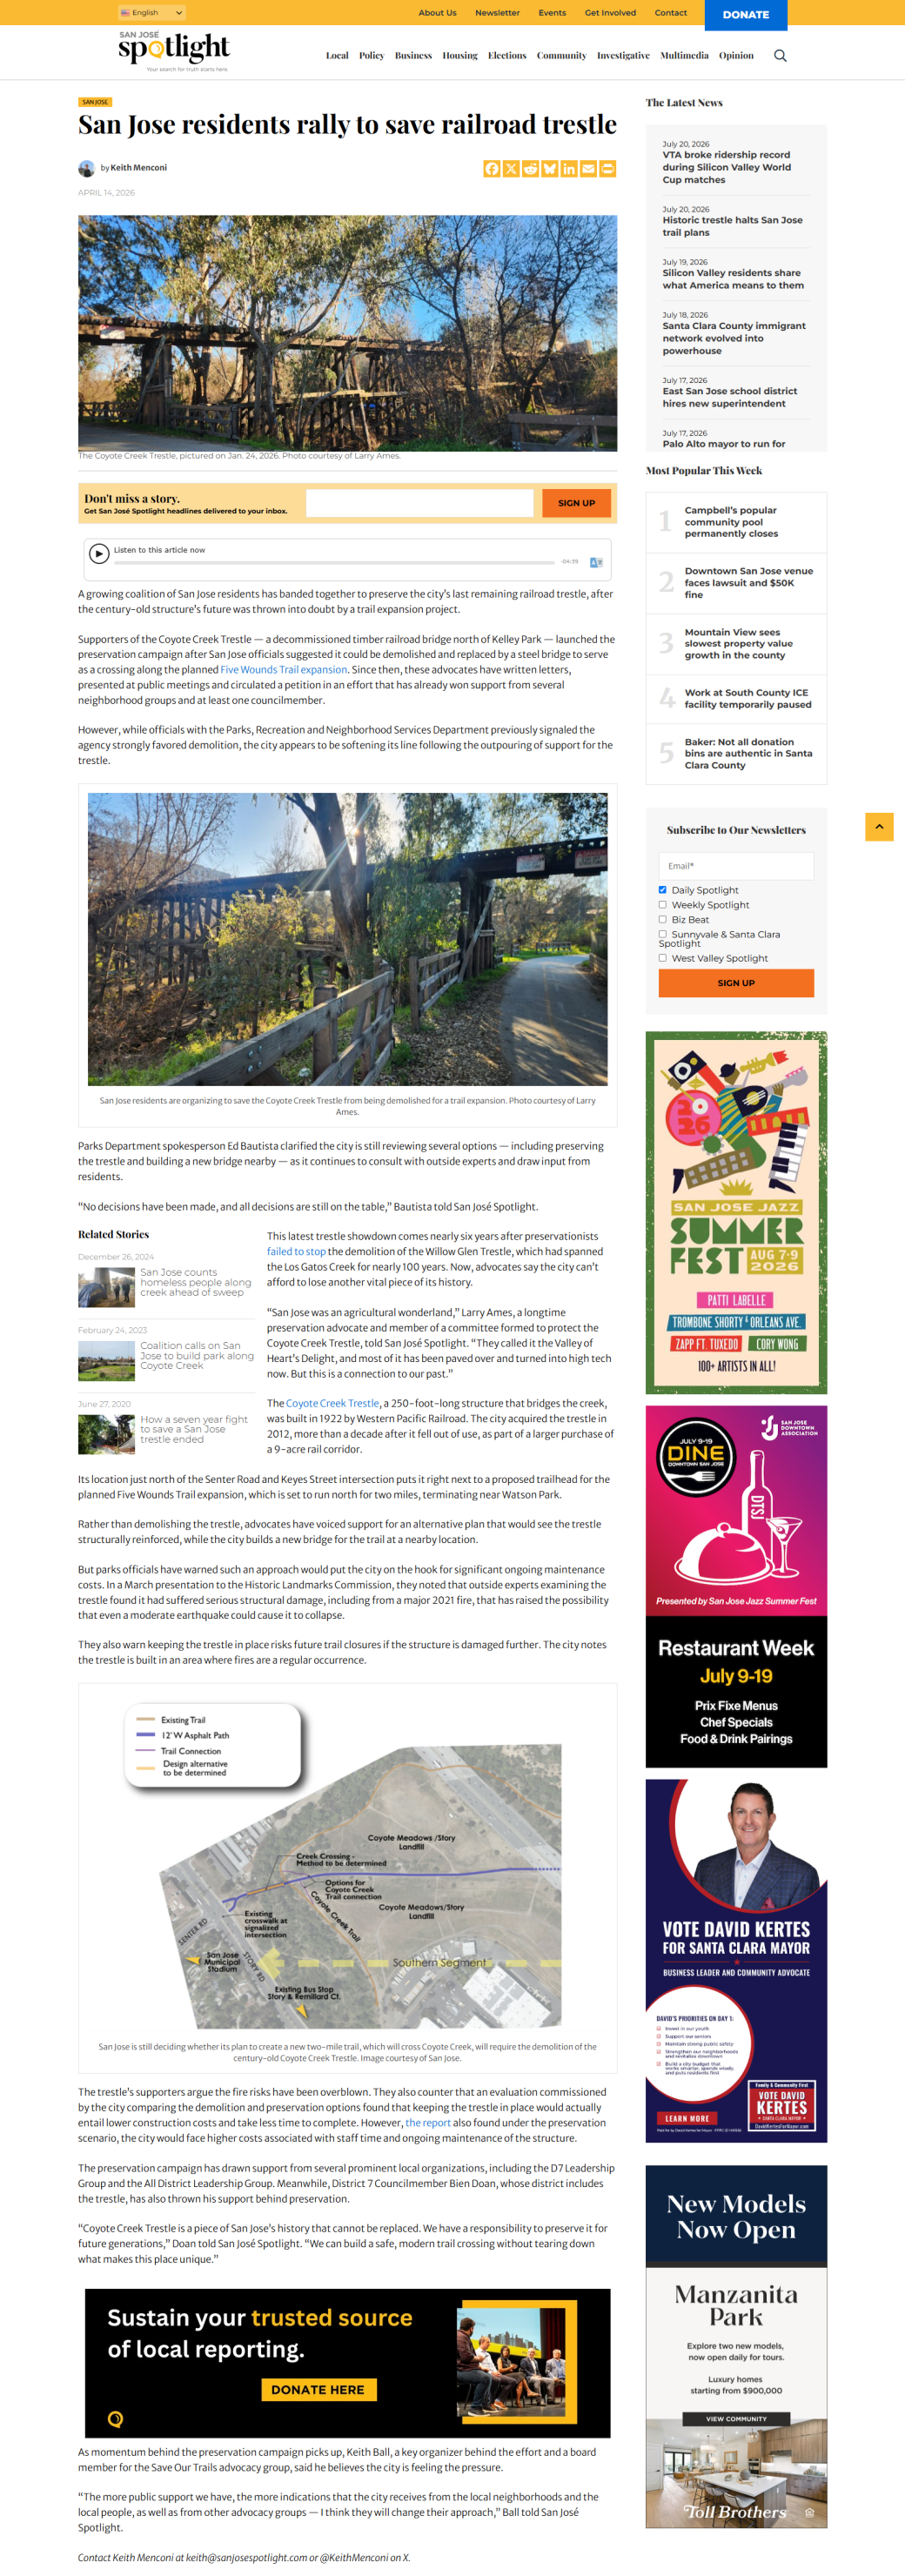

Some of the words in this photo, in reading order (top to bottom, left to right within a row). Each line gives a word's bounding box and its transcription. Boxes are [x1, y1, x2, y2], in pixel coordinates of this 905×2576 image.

[132, 9, 158, 17] English
[722, 10, 770, 20] DONATE
[118, 33, 231, 64] spotlight
[325, 50, 349, 60] Local
[359, 50, 385, 62] Policy
[394, 50, 432, 60] Business
[442, 50, 479, 61] Housing
[487, 50, 527, 60] Elections
[536, 50, 587, 62] Community
[597, 50, 651, 61] Investigative
[660, 50, 709, 60] Multimedia
[718, 50, 754, 62] Opinion
[645, 97, 665, 107] The
[667, 98, 696, 107] Latest
[697, 98, 724, 107] News
[78, 114, 123, 135] San
[126, 114, 176, 139] Jose
[181, 112, 291, 135] residents
[296, 112, 352, 139] rally
[355, 116, 379, 135] to
[385, 119, 436, 135] save
[440, 112, 538, 135] railroad
[541, 112, 618, 135] trestle
[662, 140, 679, 149] July
[679, 140, 691, 149] 20,
[661, 151, 682, 159] VTA
[684, 151, 713, 159] broke
[714, 150, 758, 161] ridership
[759, 151, 791, 159] record
[100, 164, 111, 173] by
[110, 163, 132, 171] Keith
[132, 163, 168, 171] Menconi
[104, 189, 114, 198] 14,
[645, 466, 670, 475] Most
[672, 466, 712, 477] Popular
[712, 466, 735, 475] This
[735, 466, 763, 475] Week
[84, 493, 113, 504] Don't
[115, 493, 140, 504] miss
[141, 495, 149, 504] a
[150, 494, 181, 506] story.
[558, 499, 580, 507] SIGN
[582, 499, 596, 507] UP
[684, 506, 738, 516] Campbell’s
[740, 506, 778, 516] popular
[659, 510, 672, 532] 1
[220, 665, 238, 674] Five
[240, 665, 278, 674] Wounds
[279, 664, 298, 674] Trail
[300, 665, 349, 676] expansion.
[667, 825, 716, 835] Subscribe
[717, 826, 727, 835] to
[728, 825, 750, 835] Our
[750, 825, 807, 835] Newsletters
[672, 916, 687, 924] Biz
[688, 916, 710, 924] Beat
[674, 1203, 706, 1212] SAN
[709, 1203, 754, 1212] JOSE
[757, 1203, 800, 1212] JAZZ
[77, 1229, 114, 1239] Related
[115, 1229, 150, 1239] Stories
[670, 1218, 805, 1244] SUMMER
[266, 1246, 293, 1256] failed
[305, 1248, 327, 1258] stop
[750, 1249, 775, 1260] AUG
[778, 1249, 799, 1260] 7-9
[670, 1247, 744, 1274] FEST
[751, 1261, 799, 1271] 2026
[707, 1294, 729, 1306] PATTI
[733, 1294, 767, 1306] LABELLE
[668, 1446, 724, 1461] DINE
[751, 1495, 765, 1519] DTSJ
[659, 1639, 760, 1657] Restaurant
[761, 1639, 815, 1657] Week
[700, 1667, 735, 1687] July
[737, 1668, 774, 1684] 9-19
[161, 1715, 189, 1726] Existing
[190, 1715, 206, 1724] Trail
[178, 1926, 199, 1946] SENTER
[197, 1918, 208, 1931] RD
[662, 1921, 700, 1938] VOTE
[704, 1921, 750, 1938] DAVID
[755, 1921, 811, 1938] KERTES
[662, 1942, 686, 1955] FOR
[689, 1942, 726, 1955] SANTA
[728, 1942, 767, 1955] CLARA
[770, 1942, 810, 1955] MAYOR
[243, 1951, 259, 1972] STORY
[256, 1970, 265, 1982] RD
[393, 1957, 438, 1968] Southern
[440, 1957, 487, 1969] Segment
[757, 2101, 808, 2115] KERTES
[667, 2195, 717, 2214] New
[722, 2193, 807, 2214] Models
[677, 2220, 728, 2239] Now
[733, 2220, 796, 2244] Open
[675, 2284, 798, 2304] Manzanita
[107, 2307, 190, 2327] Sustain
[194, 2312, 247, 2332] your
[251, 2307, 332, 2327] trusted
[338, 2312, 413, 2327] source
[710, 2307, 764, 2326] Park
[107, 2338, 132, 2358] of
[137, 2339, 190, 2358] local
[196, 2339, 305, 2364] reporting.
[271, 2385, 327, 2395] DONATE
[330, 2385, 365, 2395] HERE
[690, 2387, 721, 2396] starting
[721, 2386, 741, 2395] from
[742, 2386, 783, 2396] $900,000
[684, 2505, 715, 2519] Toll
[719, 2505, 787, 2519] Brothers
[77, 2553, 111, 2562] Contact
[112, 2553, 136, 2562] Keith
[136, 2553, 175, 2562] Menconi
[175, 2553, 185, 2562] at
[185, 2553, 308, 2565] keith@sanjosespotlight.com
[319, 2553, 389, 2565] @KeithMenconi
[402, 2553, 411, 2562] X.
